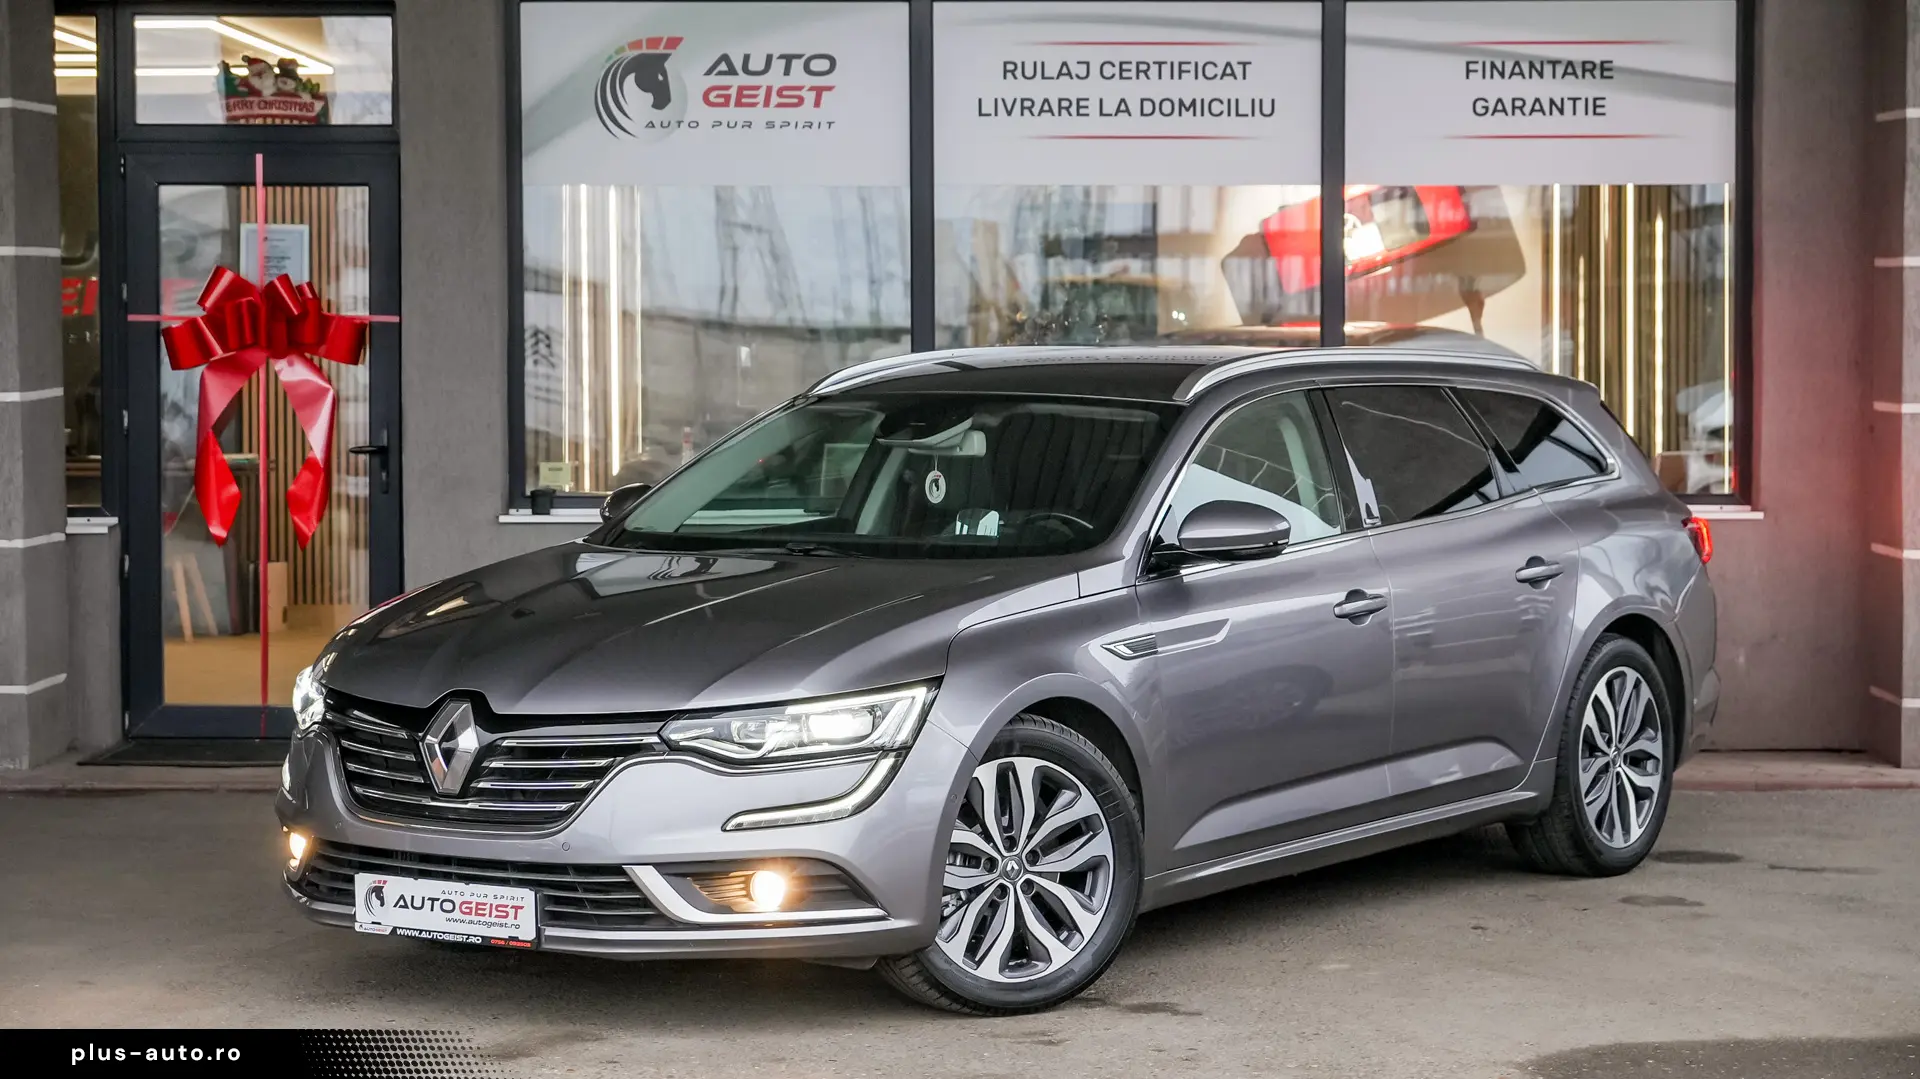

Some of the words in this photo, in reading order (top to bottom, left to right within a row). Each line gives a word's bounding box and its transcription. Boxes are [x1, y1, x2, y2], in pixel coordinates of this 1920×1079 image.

[703, 53, 837, 77] AUTO
[1002, 60, 1092, 81] RULAJ
[1099, 60, 1252, 81] CERTIFICAT
[1465, 60, 1615, 80] FINANTARE
[702, 84, 837, 109] GEIST
[977, 97, 1091, 117] LIVRARE
[1098, 97, 1132, 117] LA
[1139, 97, 1276, 117] DOMICILIU
[1472, 97, 1607, 117] GARANTIE
[644, 120, 700, 129] AUTO
[711, 120, 753, 129] PUR
[765, 120, 836, 130] SPIRIT
[441, 889, 466, 897] AUTO
[493, 894, 525, 902] SPIRIT
[445, 917, 521, 930] www.autogeist.ro
[396, 927, 482, 944] WWW.AUTOGEIST.RO
